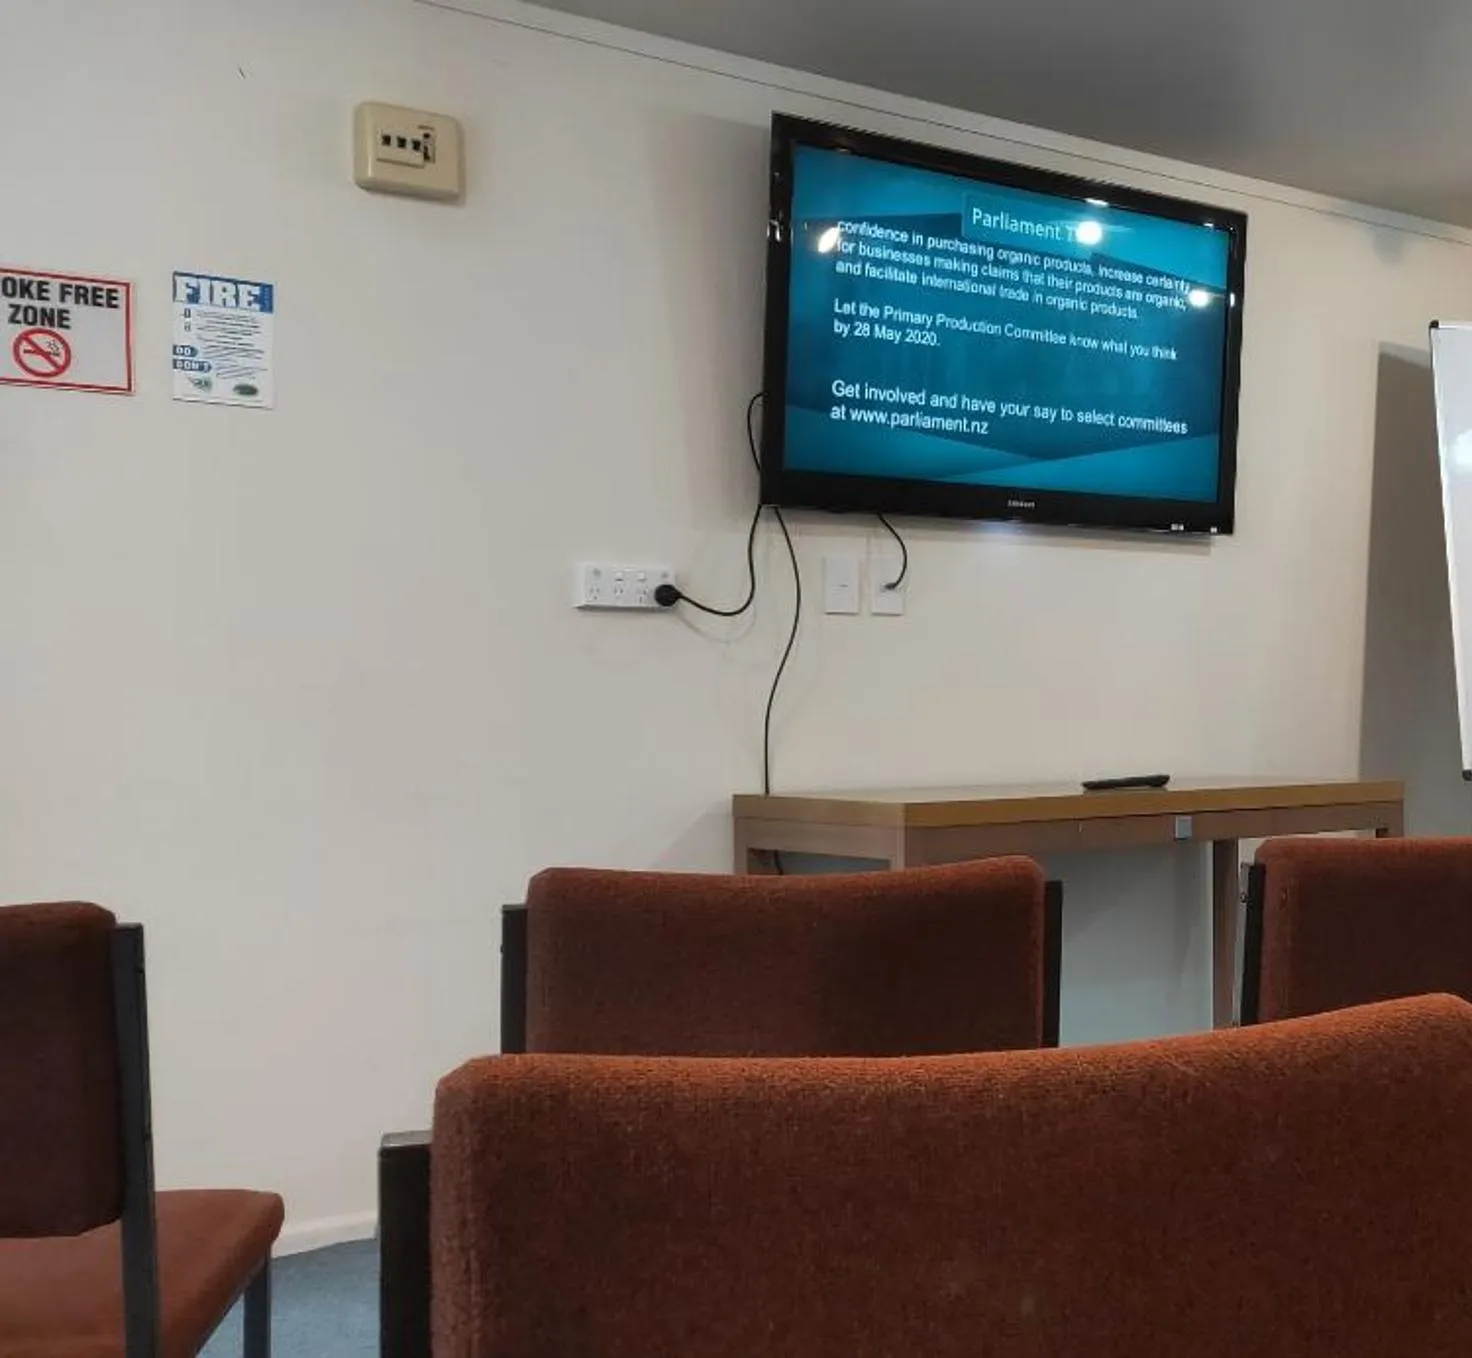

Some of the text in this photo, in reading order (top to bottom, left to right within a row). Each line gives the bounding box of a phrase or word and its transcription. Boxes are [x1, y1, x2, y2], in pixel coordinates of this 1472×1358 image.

[972, 207, 1062, 240] Parliament
[837, 220, 908, 243] confidence
[912, 231, 924, 246] in
[927, 236, 994, 261] purchasing
[997, 248, 1041, 265] organic
[836, 240, 856, 253] for
[858, 241, 930, 267] businesses
[934, 256, 979, 277] making
[981, 263, 1020, 282] claims
[1022, 269, 1044, 286] that
[1047, 274, 1073, 290] their
[1074, 280, 1123, 300] products
[1125, 289, 1144, 302] are
[836, 259, 862, 276] and
[865, 262, 917, 285] facilitate
[921, 272, 996, 297] international
[999, 285, 1029, 302] trade
[1034, 291, 1043, 304] in
[1046, 295, 1088, 312] organic
[0, 276, 120, 310] OKE FREE
[176, 276, 260, 310] FIRE
[8, 303, 71, 330] ZONE
[834, 298, 1178, 361] Let the Primary Production Committee know what you think
[834, 318, 941, 346] by 28 May 2020.
[176, 345, 192, 355] DO
[830, 404, 989, 435] at www.parliament.nz
[832, 379, 1189, 435] Get involved and have your say to select committees
